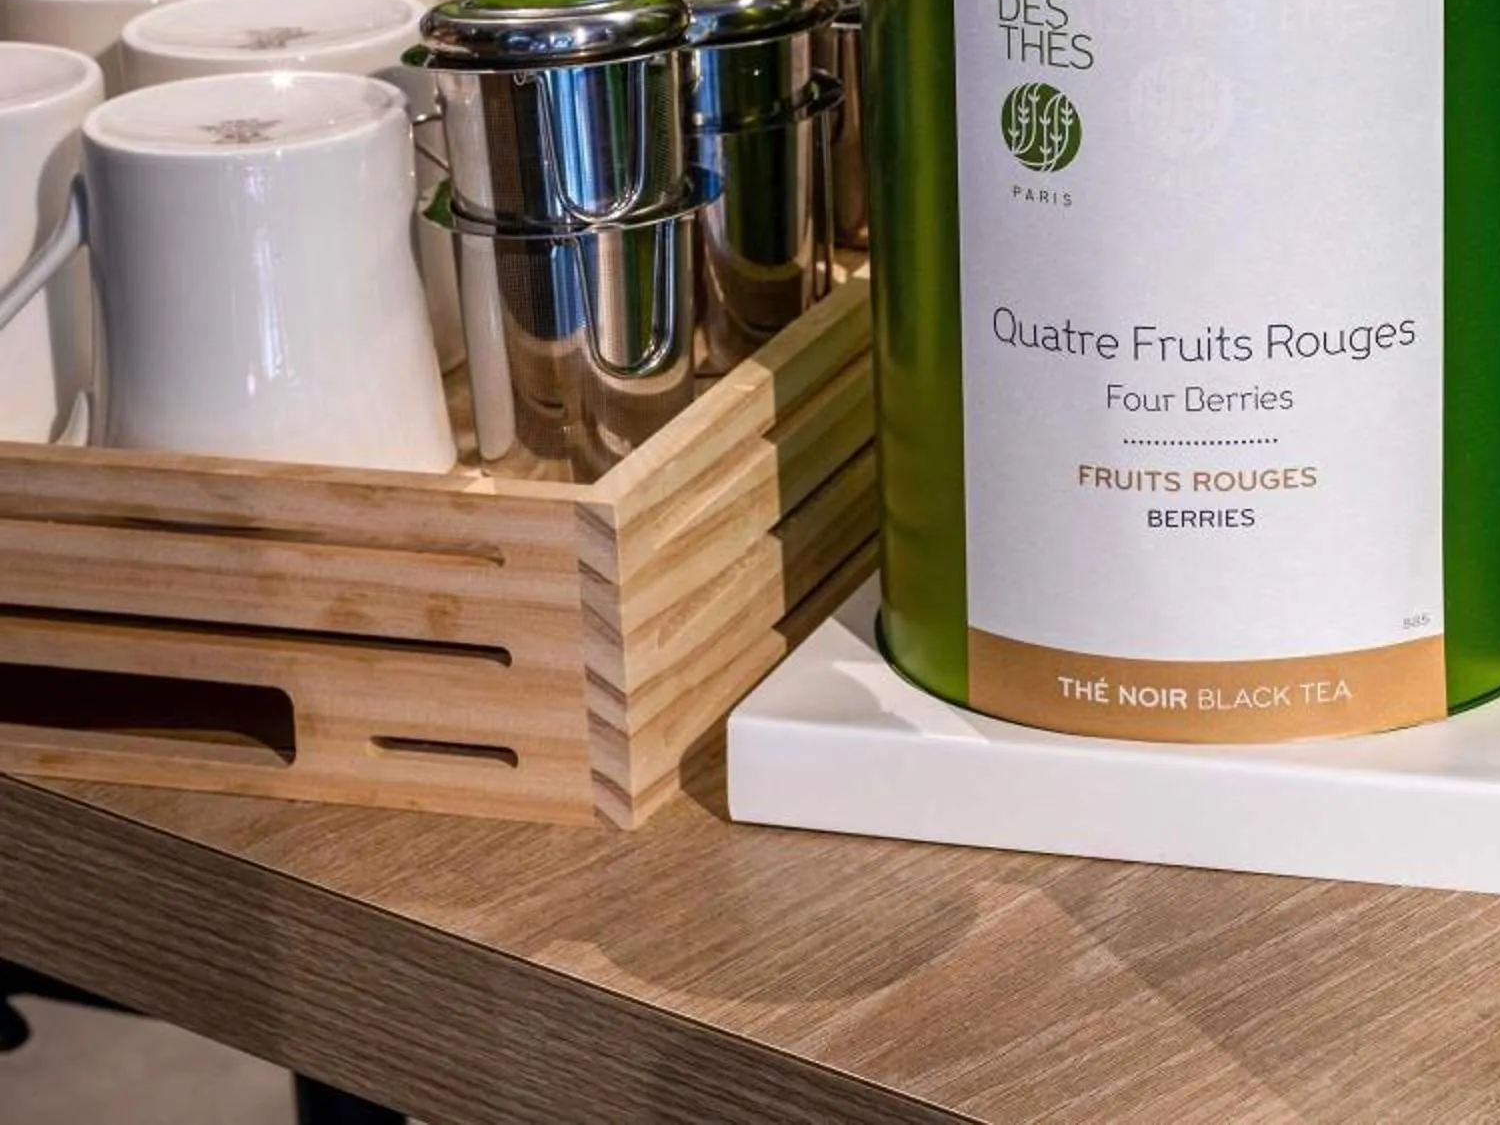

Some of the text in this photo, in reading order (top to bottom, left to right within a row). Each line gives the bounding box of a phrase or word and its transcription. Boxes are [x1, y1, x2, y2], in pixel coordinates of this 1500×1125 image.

[999, 24, 1095, 70] THÉS
[1013, 186, 1072, 206] PARIS
[993, 307, 1416, 362] Quatre Fruits Rouges
[1107, 385, 1294, 413] Four Berries
[1078, 465, 1318, 492] FRUITS ROUGES
[1147, 508, 1255, 528] BERRIES
[1058, 676, 1352, 710] THÉ NOIR BLACK TEA
